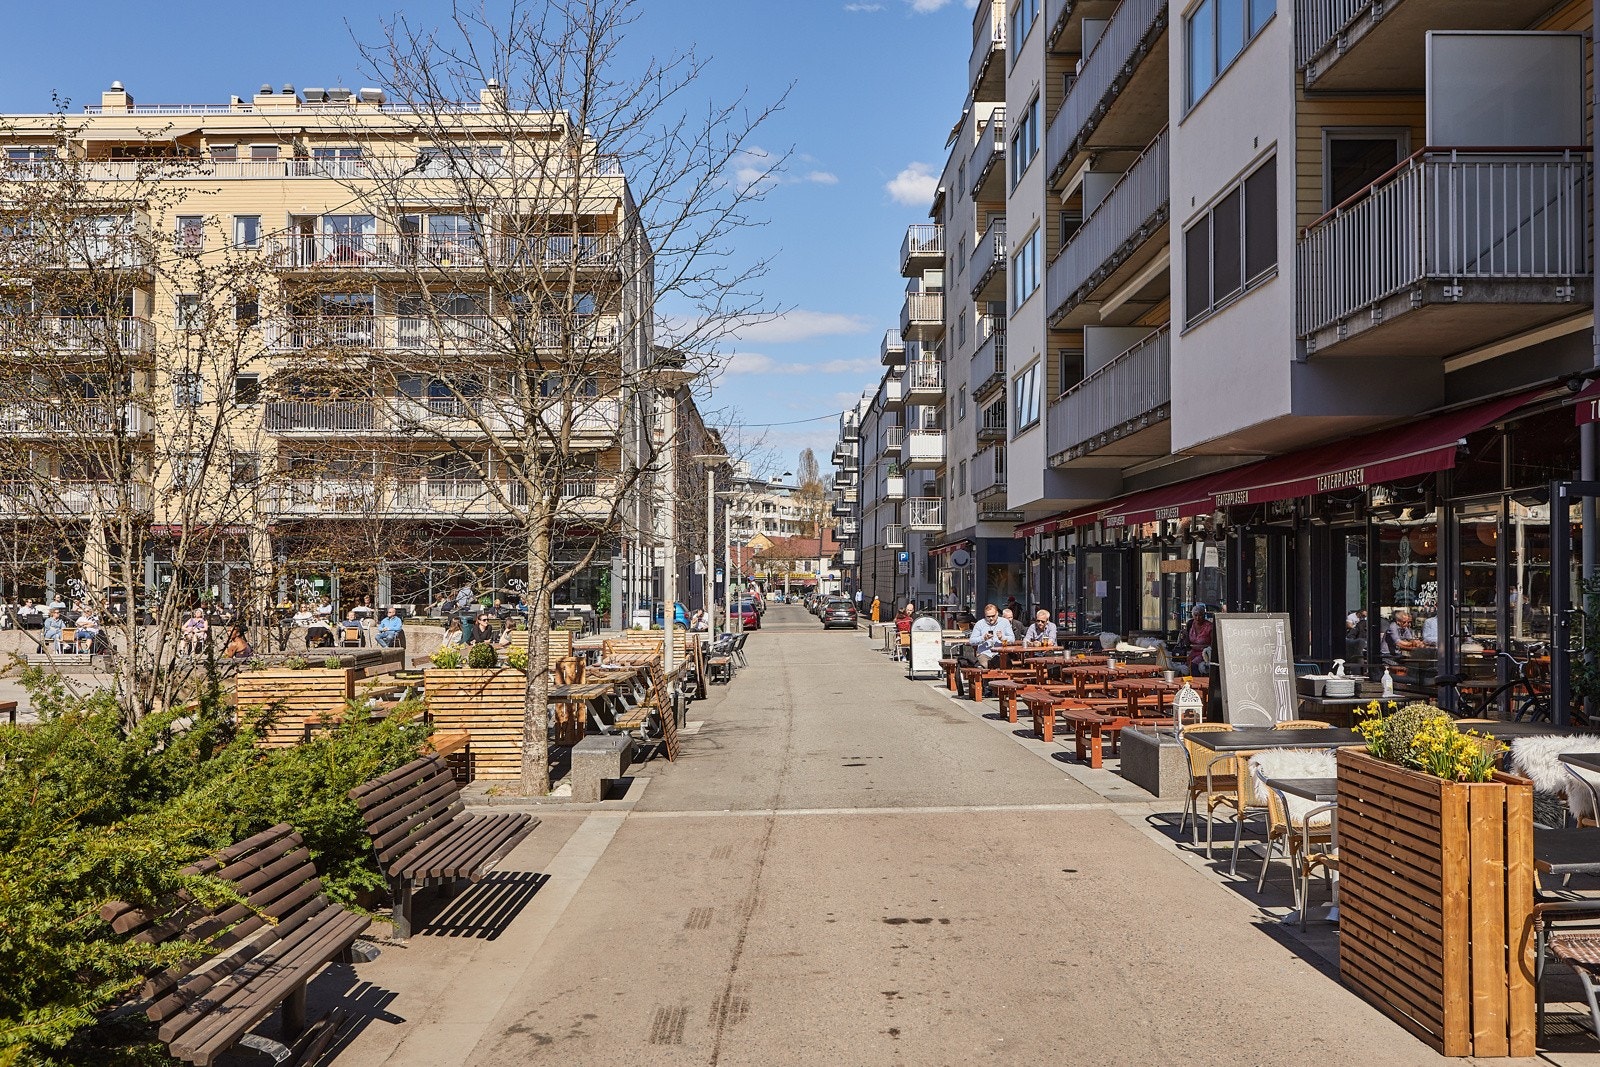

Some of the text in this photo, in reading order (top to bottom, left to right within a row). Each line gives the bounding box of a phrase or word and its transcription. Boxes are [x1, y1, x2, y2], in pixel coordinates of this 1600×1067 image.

[1317, 468, 1364, 491] TEATERPLASSEN
[1215, 491, 1249, 506] TEATERPLASSEN
[900, 553, 906, 561] P
